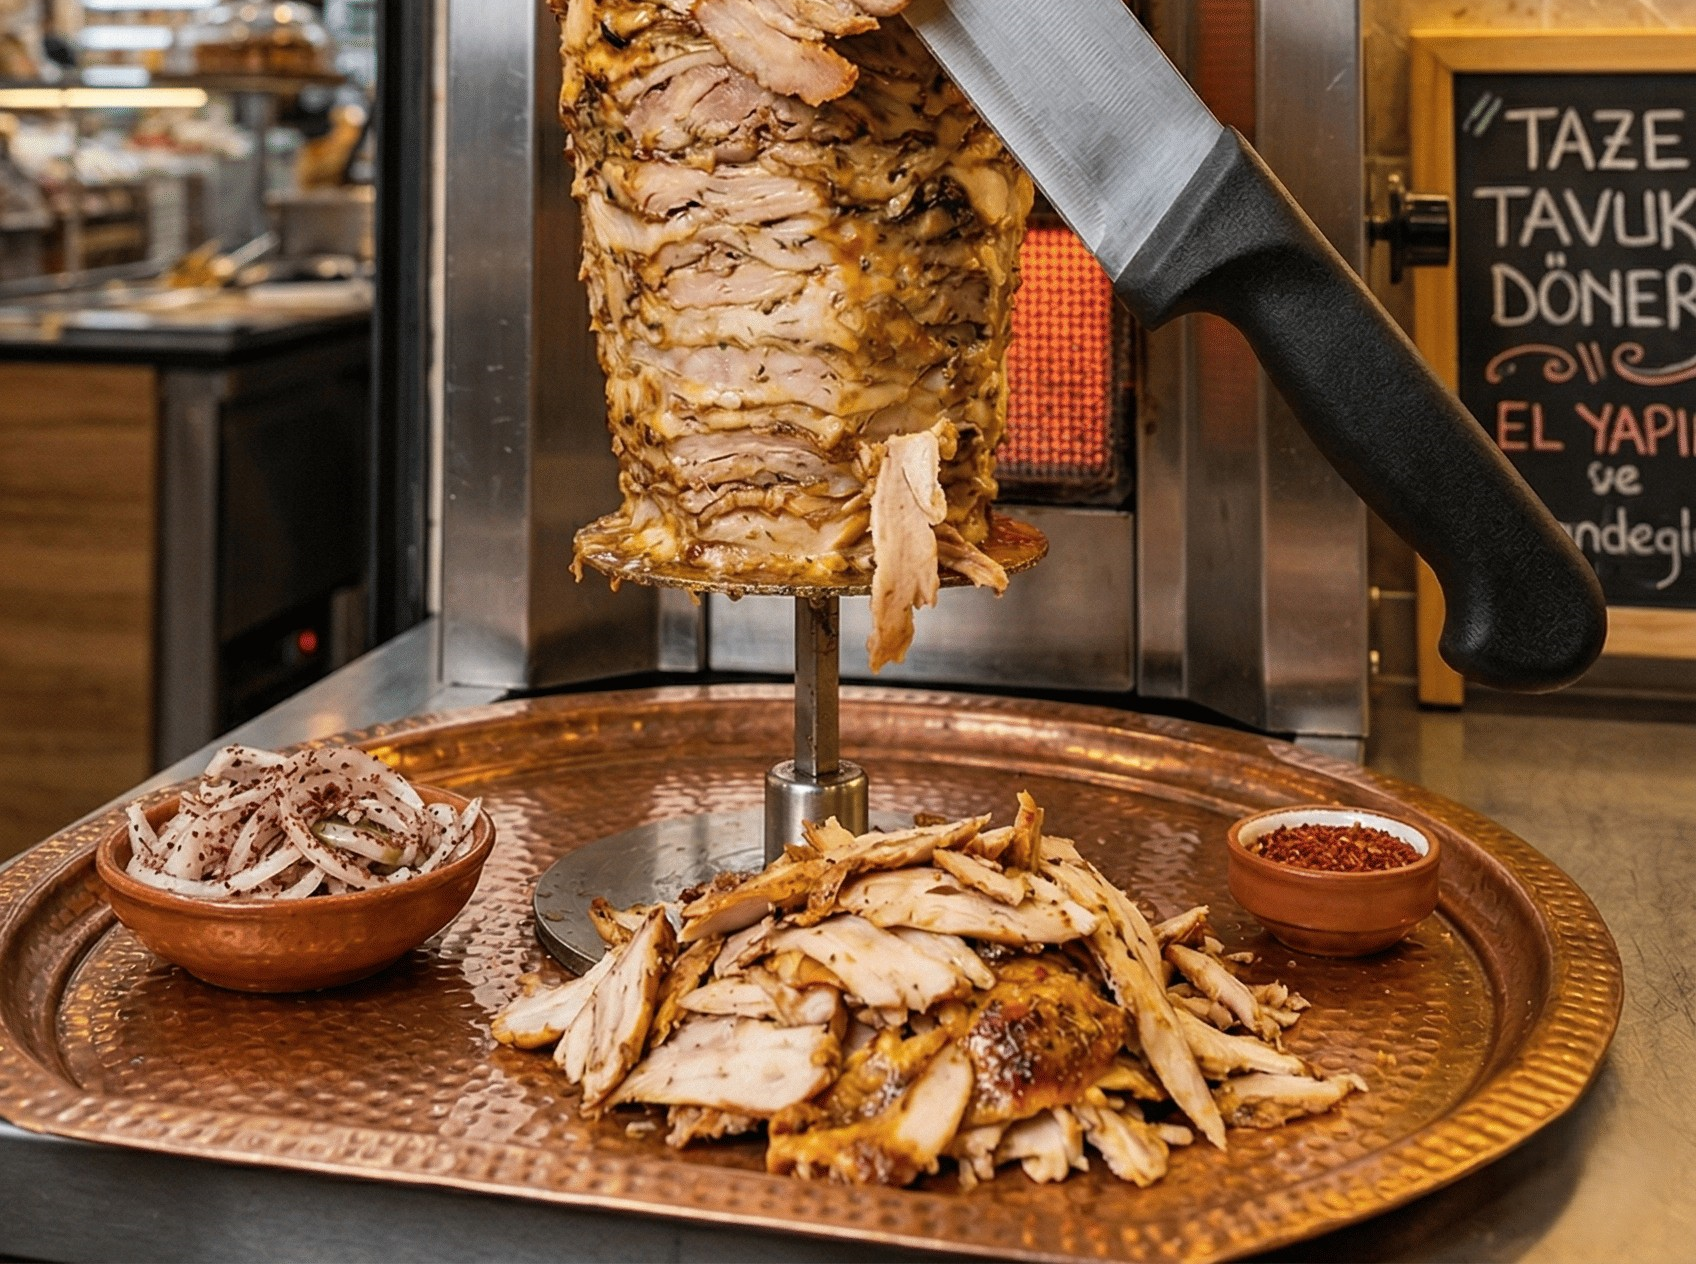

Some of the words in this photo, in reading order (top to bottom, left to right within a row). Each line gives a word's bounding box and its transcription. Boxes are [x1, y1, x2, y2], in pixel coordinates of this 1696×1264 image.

[1504, 106, 1690, 171] TAZE
[1472, 186, 1696, 250] TAVUK
[1490, 251, 1696, 330] DÖNER
[1497, 400, 1565, 452] EL
[1574, 402, 1696, 458] YAPI
[1587, 461, 1643, 495] ve
